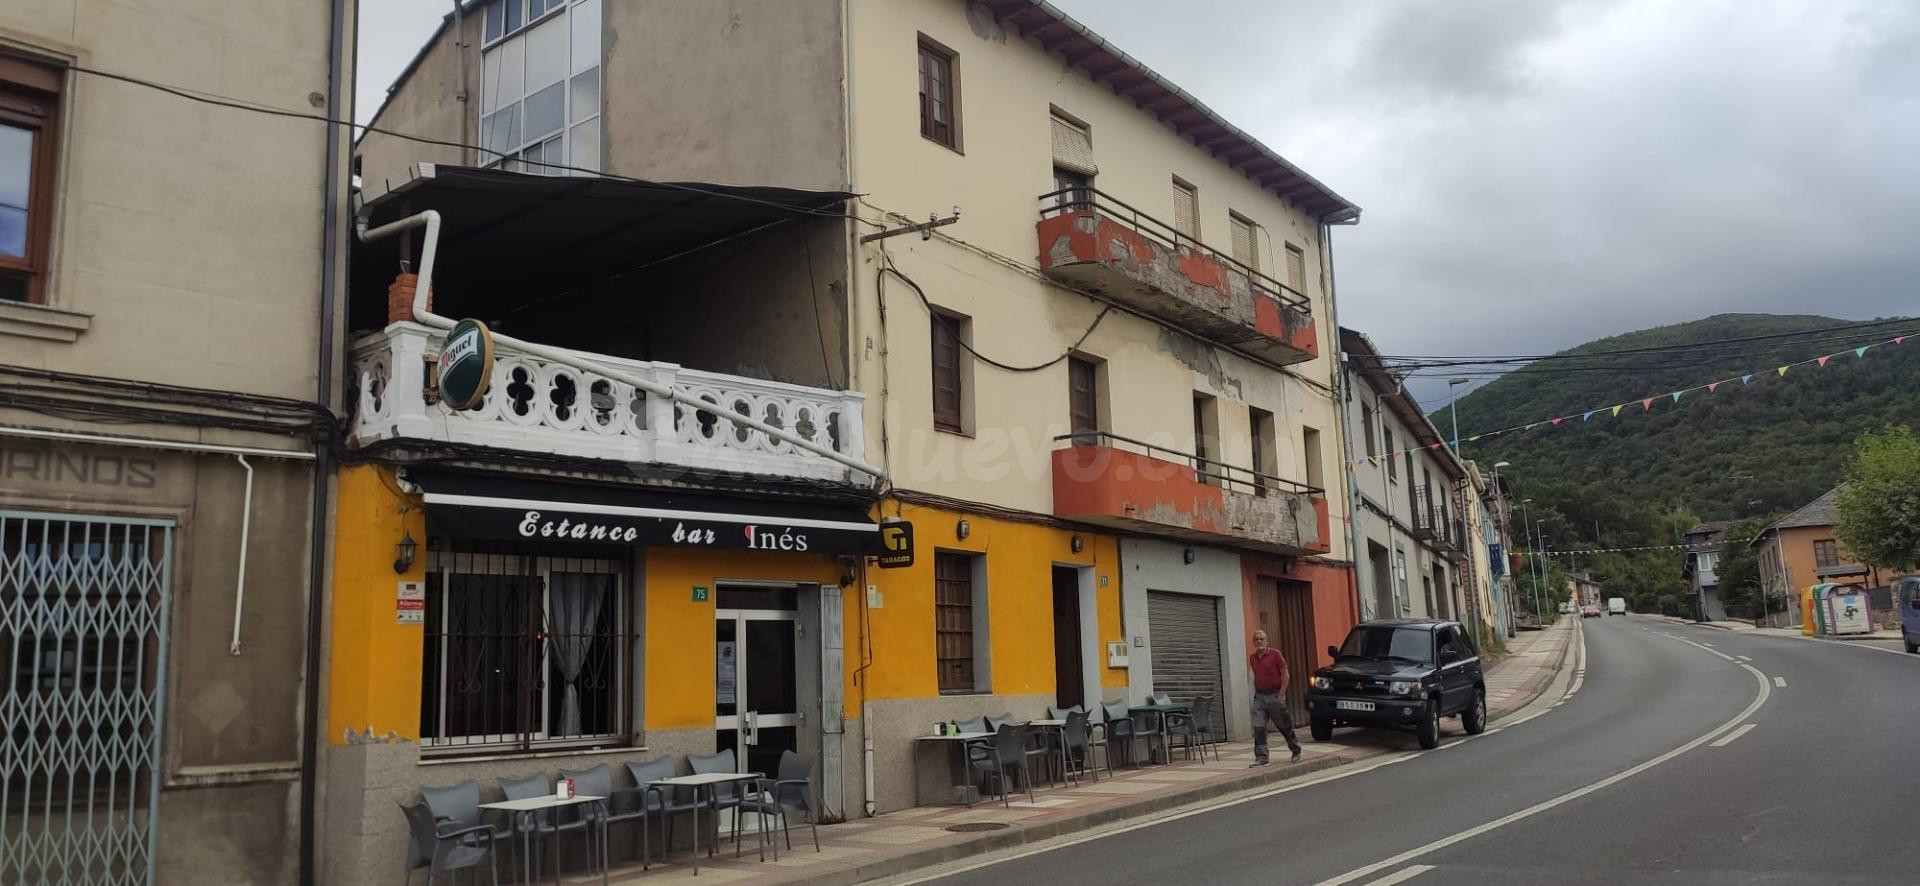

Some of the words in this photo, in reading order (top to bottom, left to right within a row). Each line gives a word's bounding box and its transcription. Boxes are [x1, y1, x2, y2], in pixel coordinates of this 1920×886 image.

[519, 511, 638, 541] Estanco
[671, 522, 715, 544] bar
[745, 525, 808, 551] Inés
[696, 589, 705, 599] 75
